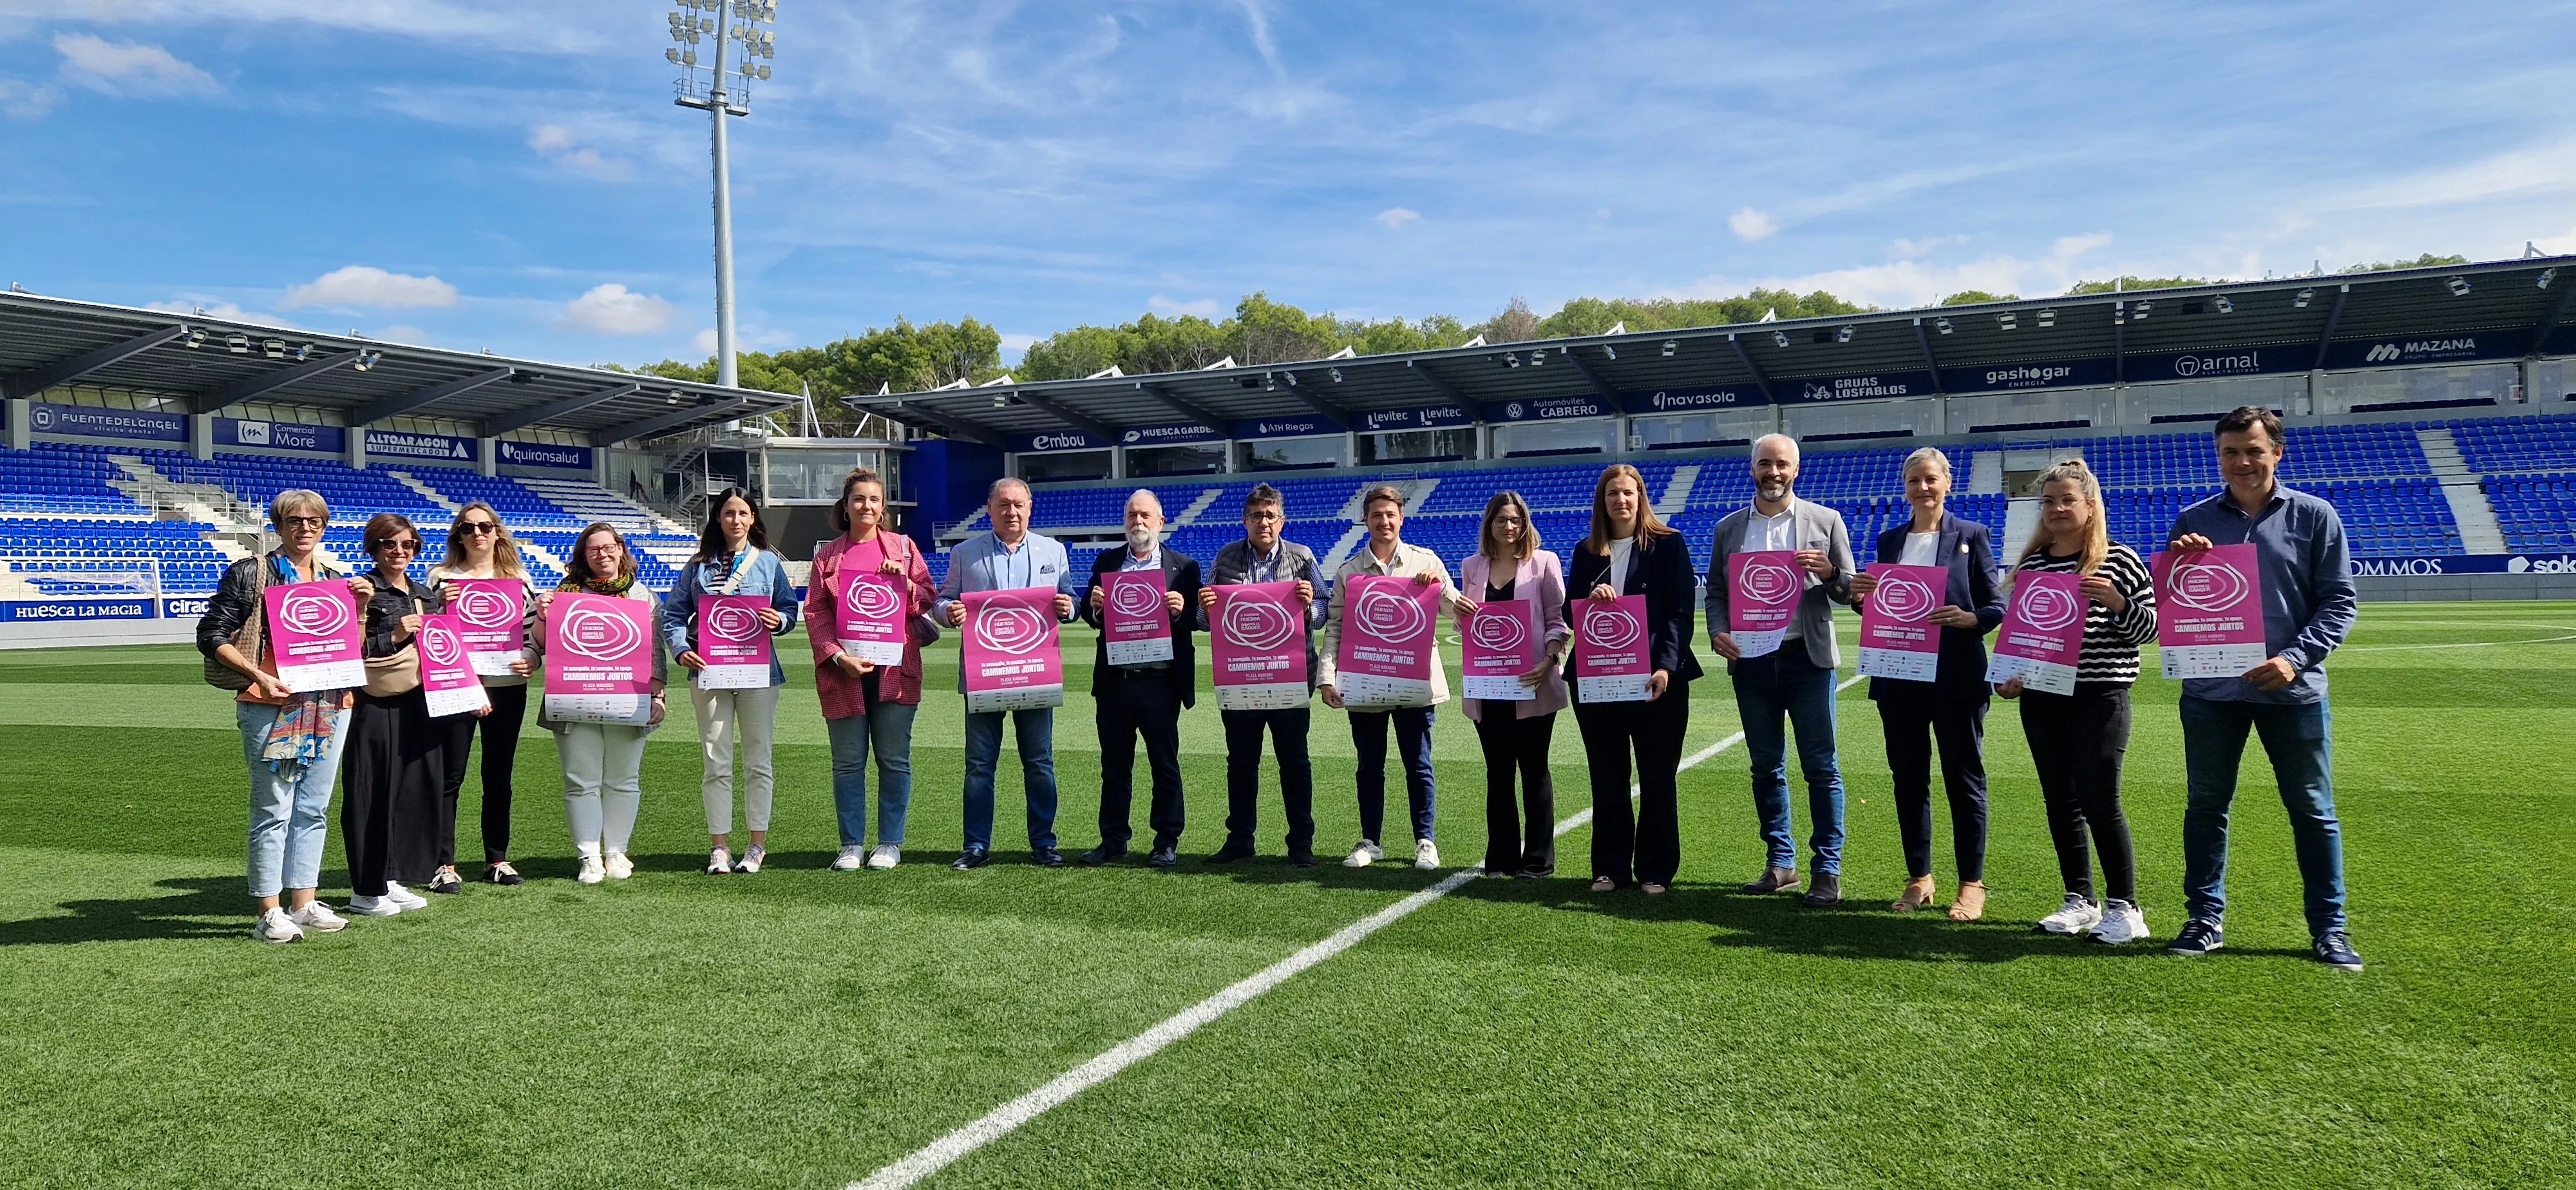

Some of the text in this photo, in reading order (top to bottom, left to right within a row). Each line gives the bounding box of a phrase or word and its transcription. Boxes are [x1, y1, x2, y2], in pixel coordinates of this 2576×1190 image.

[2405, 338, 2475, 353] MAZANA
[2202, 352, 2259, 370] arnal
[1986, 366, 2071, 384] gashogar
[2202, 367, 2260, 375] ELECTRICIDAD
[1835, 377, 1878, 388] GRUAS
[1836, 385, 1906, 399] LOSFABLOS
[1533, 398, 1585, 408] Automóviles
[1667, 392, 1736, 406] navasola
[1374, 411, 1408, 422] Levitec
[1426, 407, 1462, 419] Levitec
[1540, 405, 1598, 418] CABRERO
[274, 423, 316, 435] Comercial
[1142, 426, 1215, 437] HUESCA GARDE
[1268, 423, 1283, 432] ATH
[275, 432, 316, 448] Moré
[366, 433, 450, 449] ALTOARAGON
[1033, 433, 1085, 449] embou
[371, 444, 446, 456] SUPERMERCADOS
[2174, 622, 2244, 632] CAMINEMOS JUNTOS
[1354, 651, 1414, 665] CAMINEMOS JUNTOS
[981, 664, 1045, 677] CAMINEMOS JUNTOS
[1228, 661, 1289, 672] CAMINEMOS JUNTOS
[563, 672, 633, 681] CAMINEMOS JUNTOS
